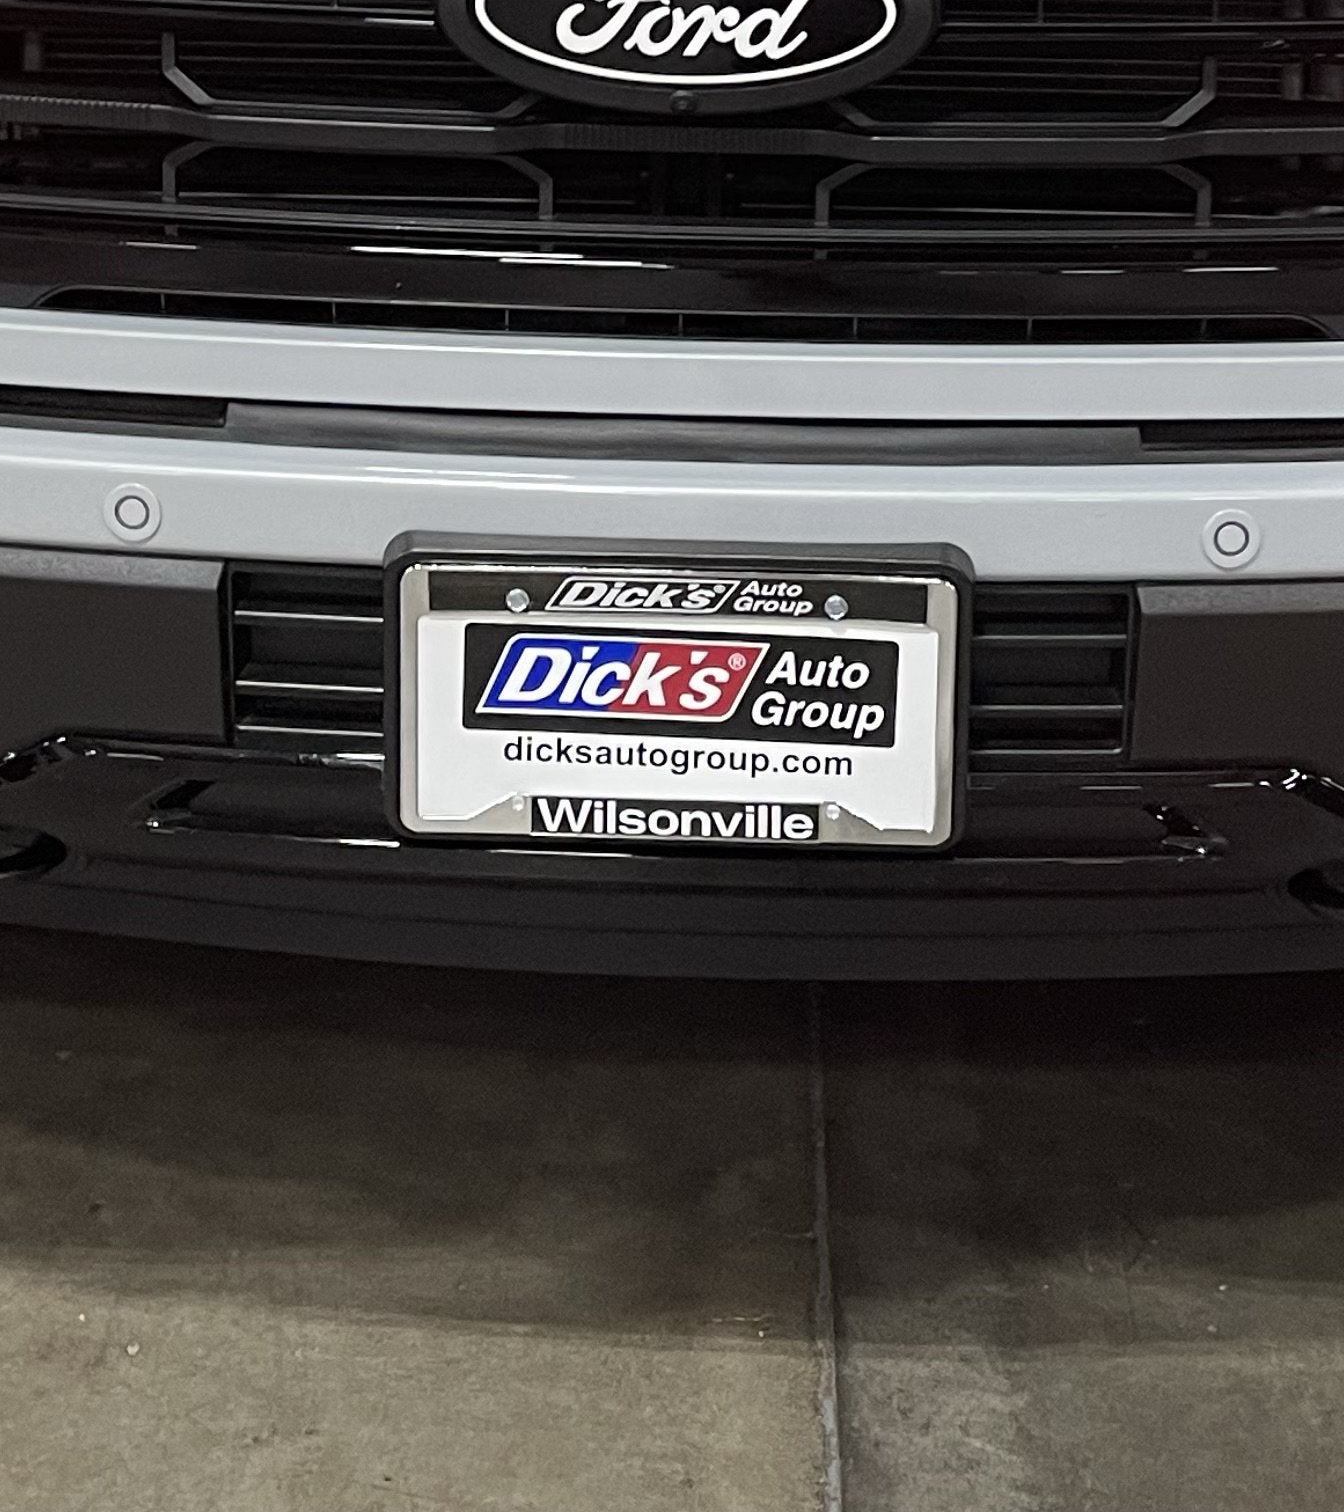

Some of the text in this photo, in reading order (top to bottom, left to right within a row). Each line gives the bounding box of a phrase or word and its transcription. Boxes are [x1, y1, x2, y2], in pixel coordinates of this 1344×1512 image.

[733, 596, 814, 617] Group
[741, 580, 803, 598] Auto
[765, 651, 871, 690] Auto
[751, 691, 885, 738] Group
[503, 736, 854, 779] dicksautogroup.com
[537, 799, 815, 840] Wilsonville
